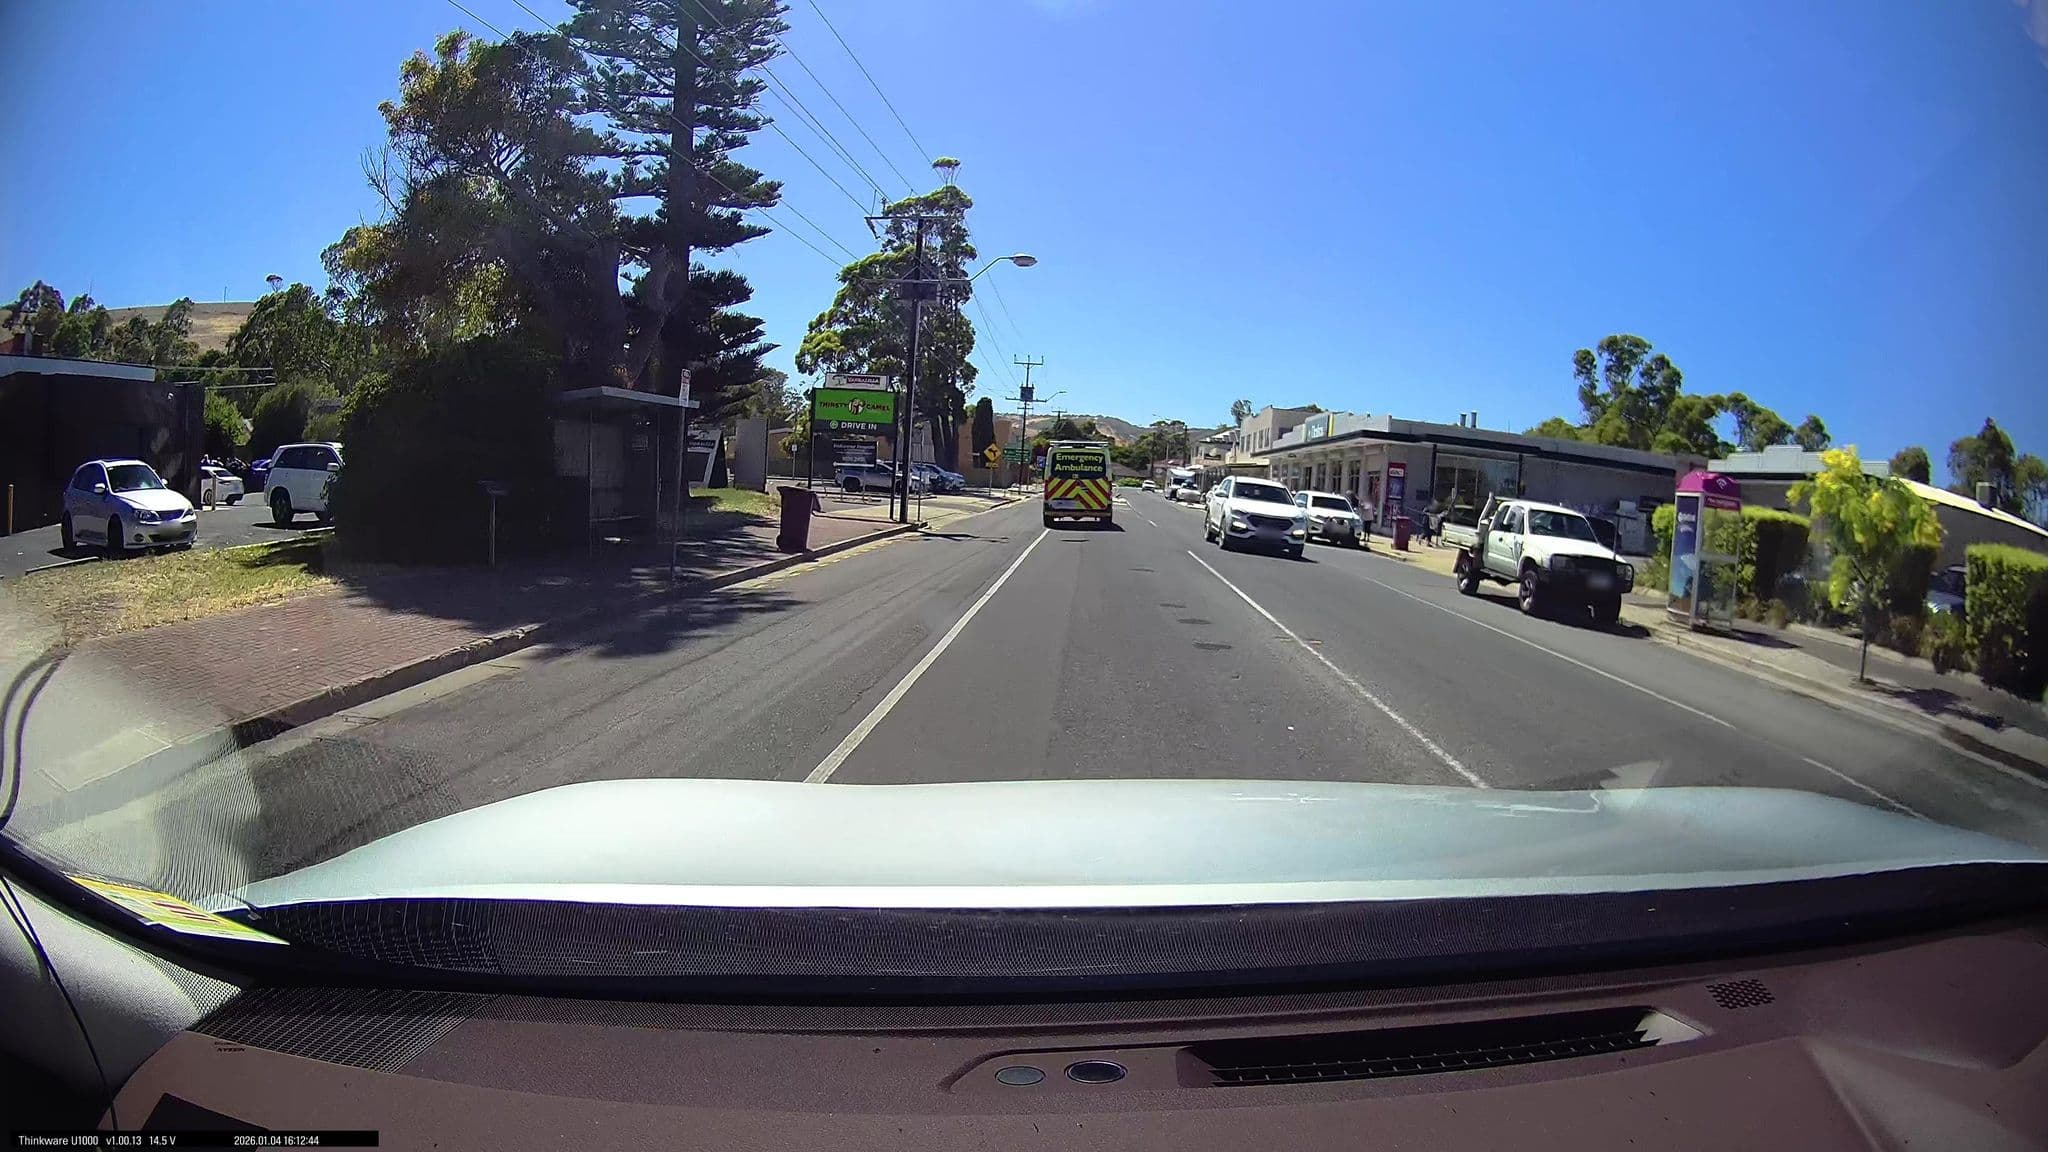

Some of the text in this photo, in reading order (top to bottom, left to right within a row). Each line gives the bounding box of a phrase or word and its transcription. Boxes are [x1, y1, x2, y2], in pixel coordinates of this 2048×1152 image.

[819, 401, 890, 411] THIRSTY CAMEL
[841, 421, 866, 430] DRIVE
[1055, 453, 1103, 463] Emergency
[1055, 463, 1103, 472] Ambulance
